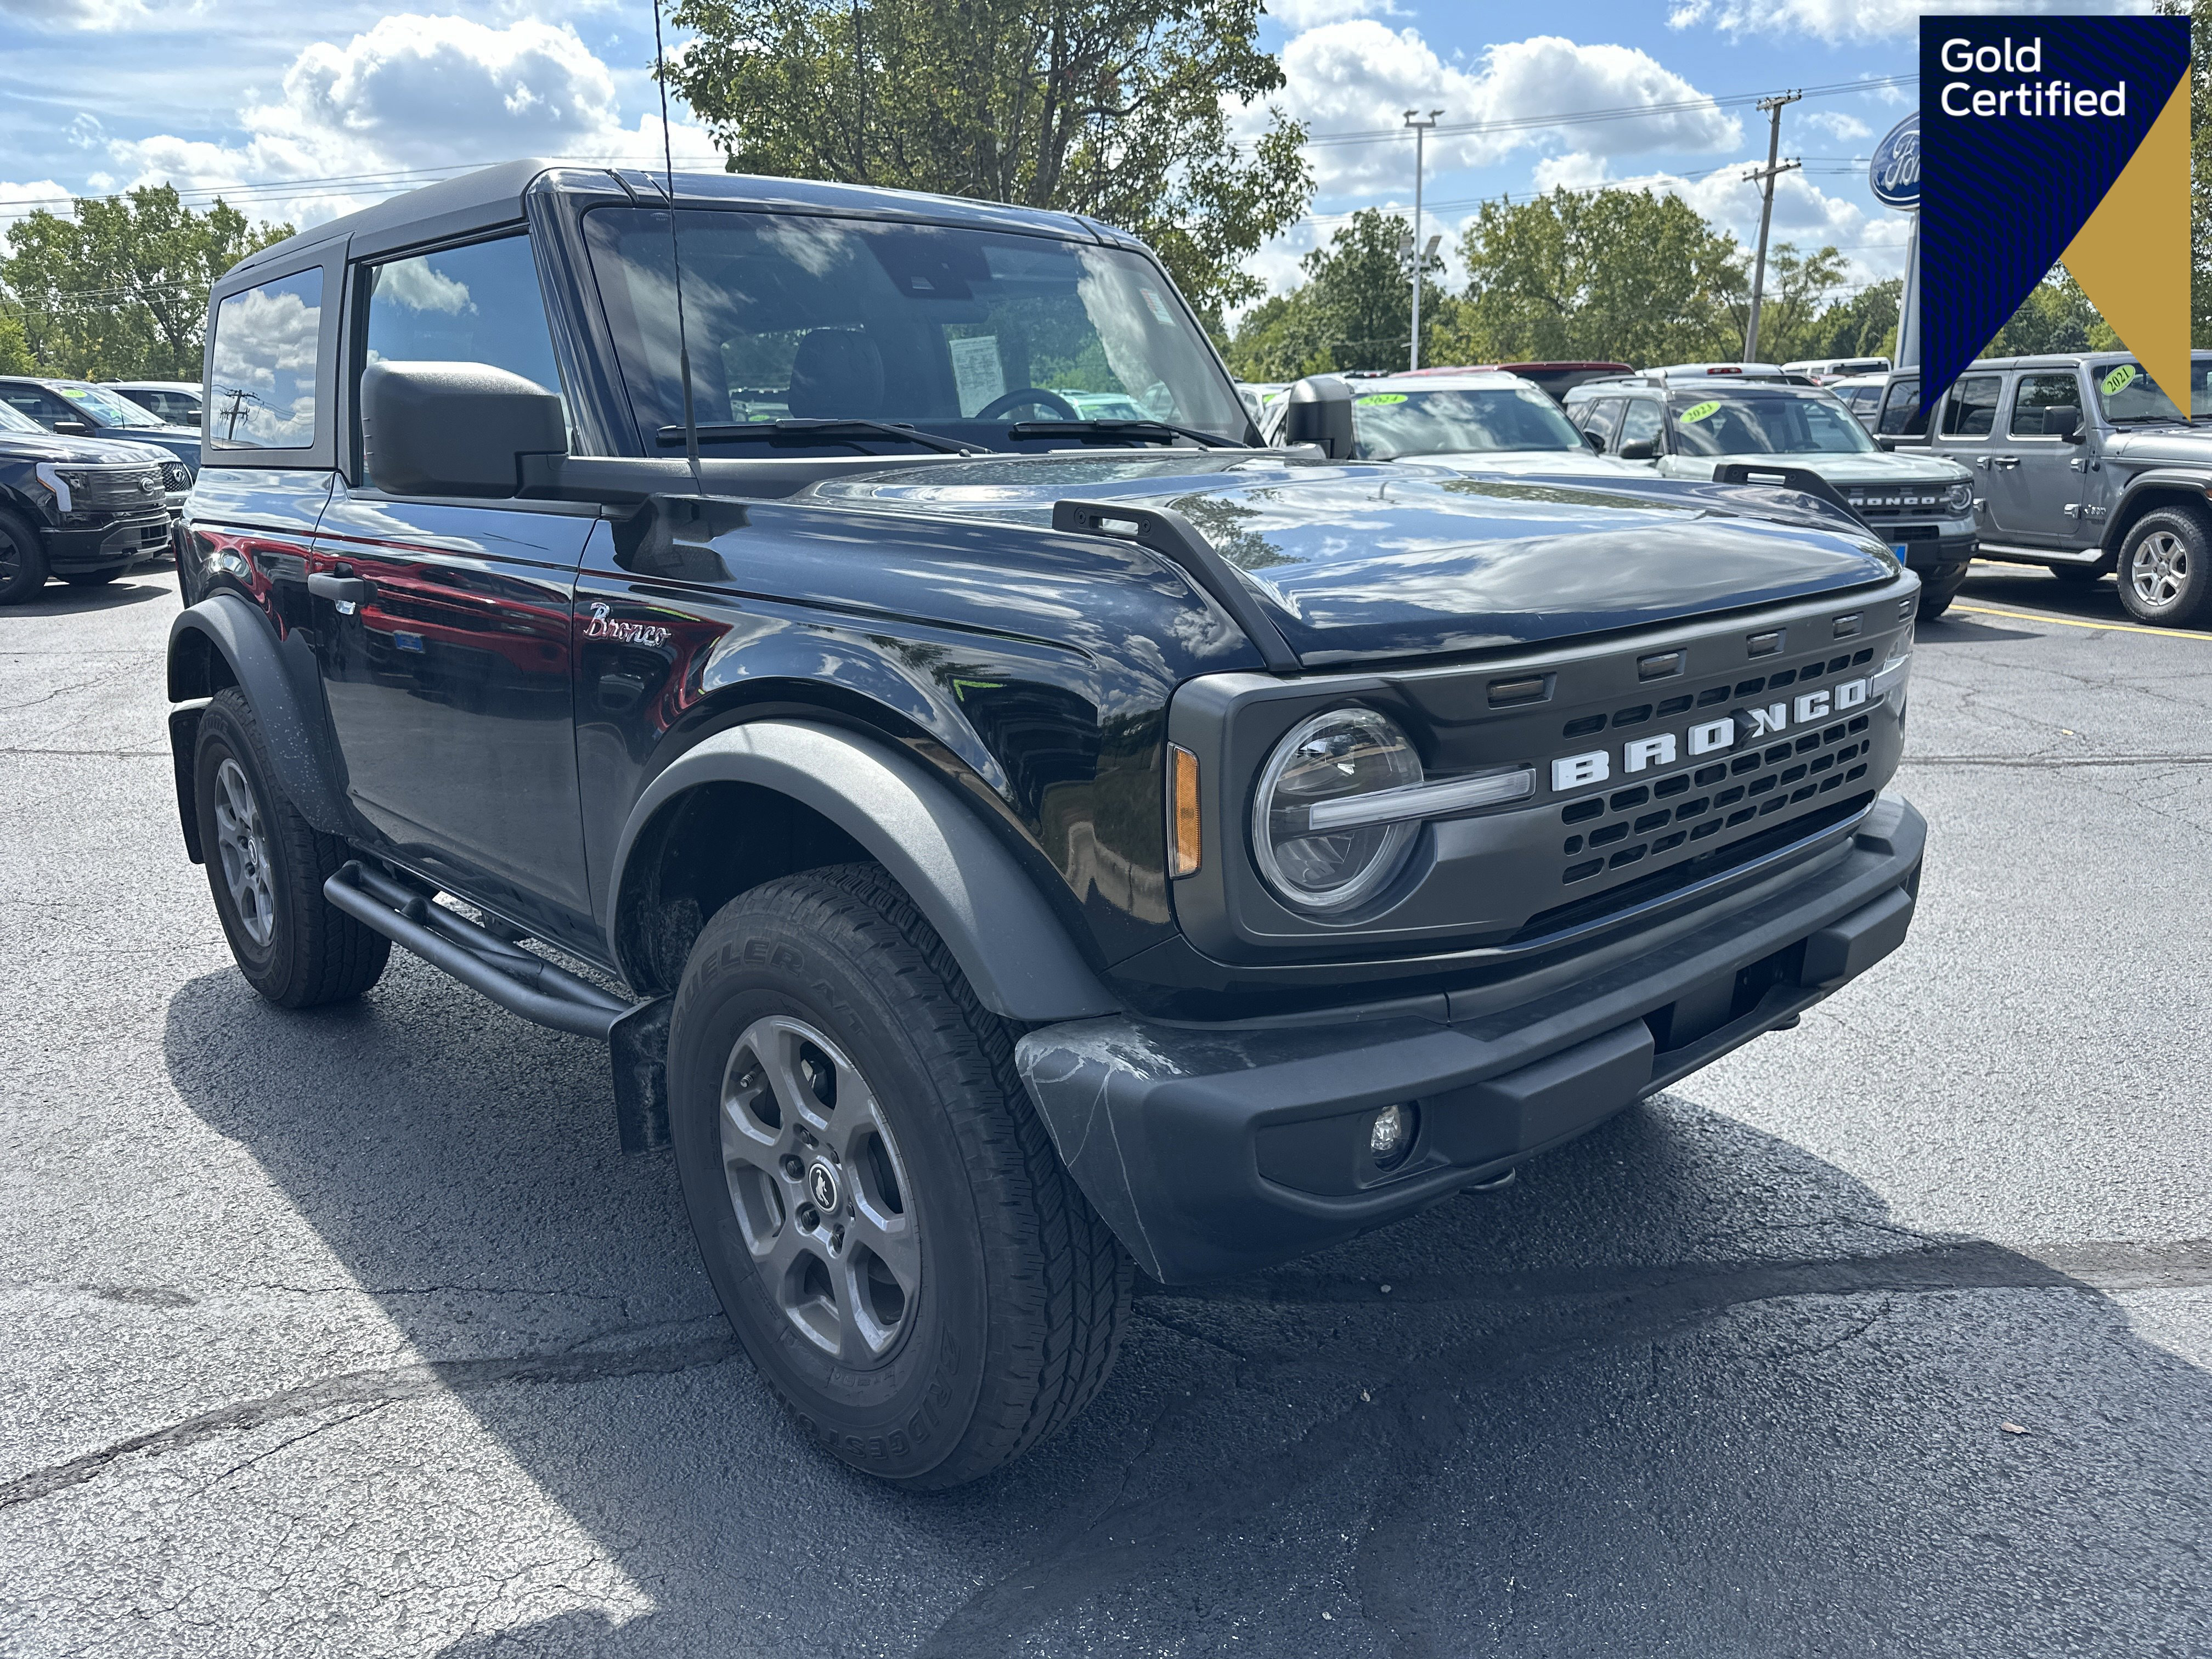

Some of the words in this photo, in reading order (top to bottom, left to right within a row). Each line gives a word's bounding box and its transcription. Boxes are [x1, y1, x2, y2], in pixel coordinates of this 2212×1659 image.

[1885, 129, 1920, 191] Fo
[2107, 367, 2130, 392] 2021
[1847, 496, 1936, 506] RONCO
[583, 602, 673, 647] Bronco
[1551, 678, 1867, 792] BRONCO
